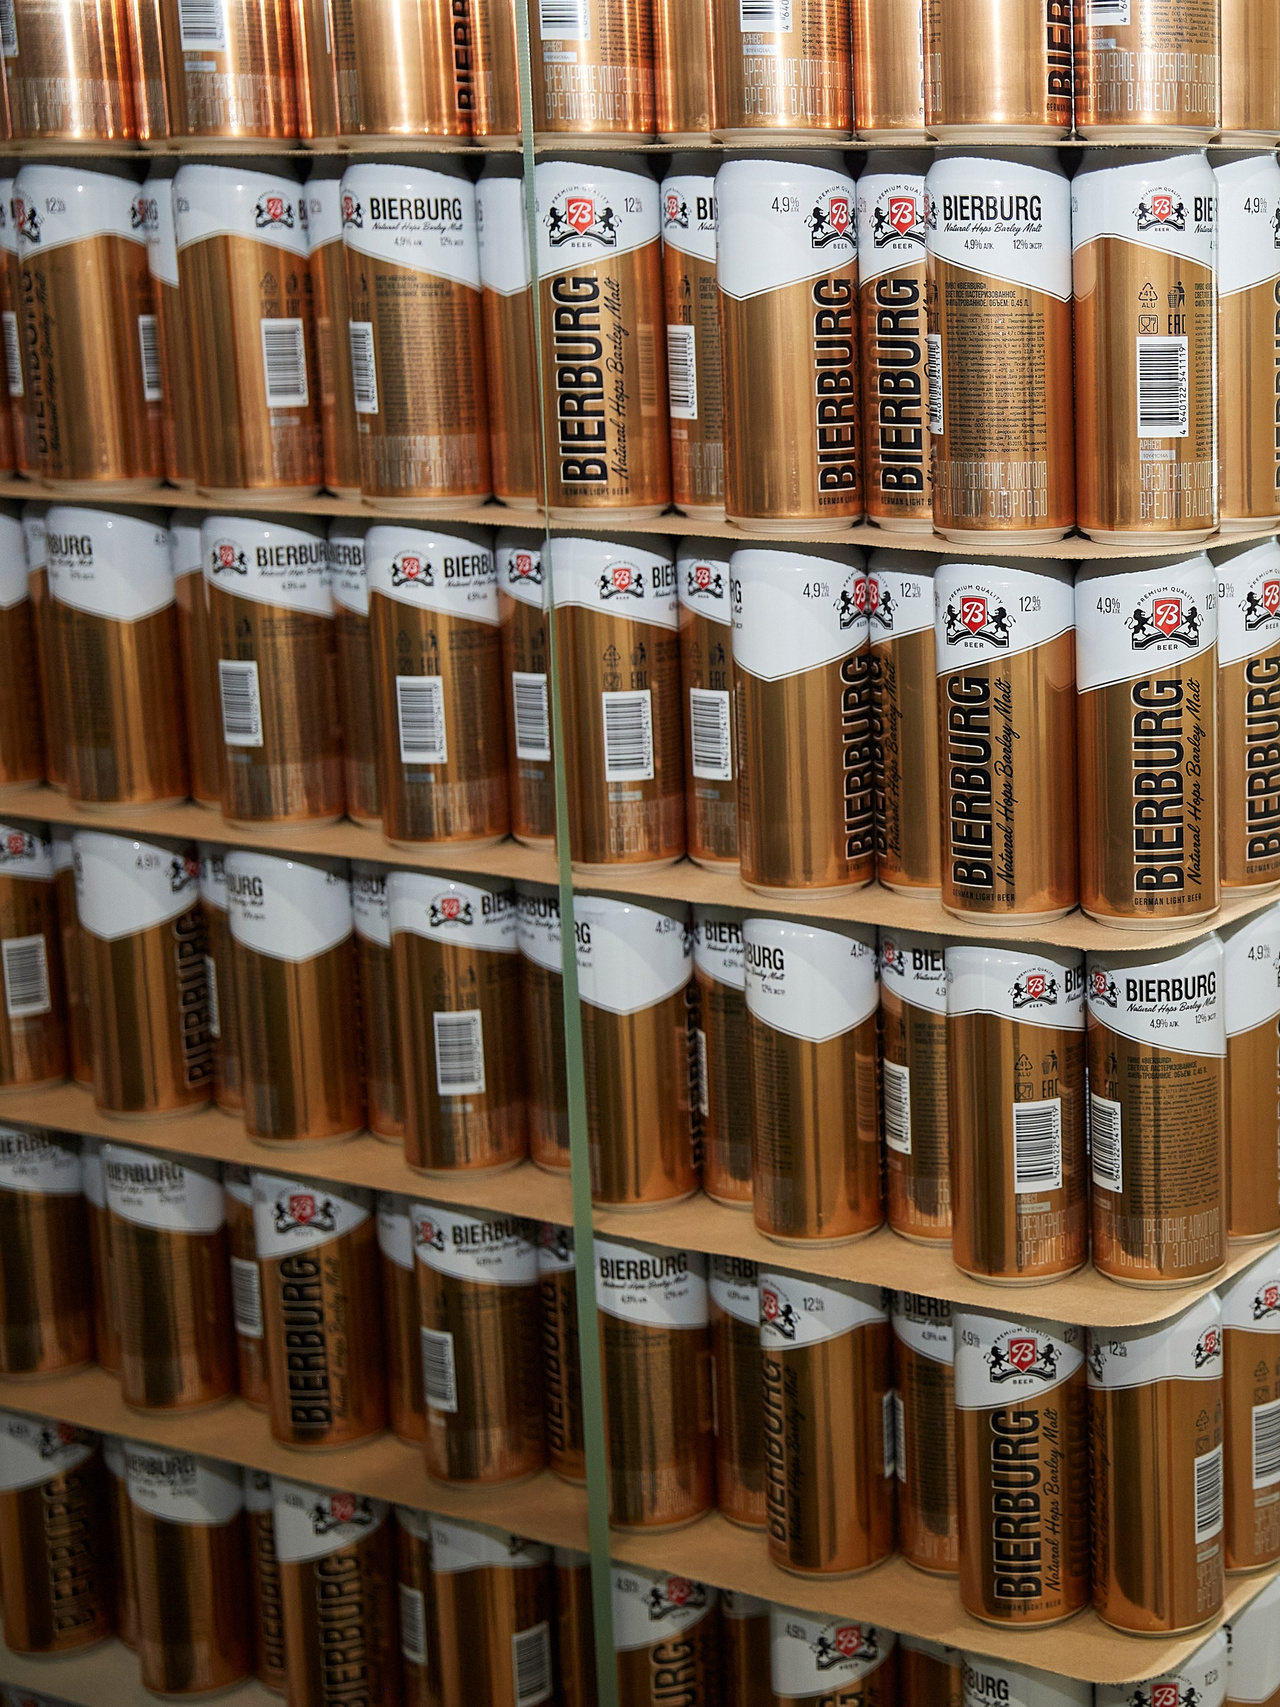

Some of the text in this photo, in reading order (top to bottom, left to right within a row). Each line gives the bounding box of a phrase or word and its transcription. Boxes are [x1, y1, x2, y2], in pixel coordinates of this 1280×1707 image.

[370, 197, 462, 220] BIERBURG
[569, 202, 592, 226] B
[892, 202, 916, 225] B
[943, 195, 1042, 221] BIERBURG
[943, 222, 972, 233] Natural
[971, 222, 993, 235] Hops
[1022, 222, 1043, 233] Malt
[1167, 314, 1187, 335] EAC
[551, 276, 608, 484] BIERBURG
[604, 276, 630, 480] Natural Hops Barley Malt
[812, 279, 856, 492] BIERBURG
[875, 279, 923, 492] BIERBURG
[989, 489, 1048, 518] ЗДОРОВЬЮ
[948, 586, 1004, 605] PREMIUM QUALITY
[1136, 586, 1197, 608] PREMIUM QUALITY
[1264, 584, 1280, 607] B
[962, 601, 985, 624] B
[1154, 603, 1179, 628] B
[964, 641, 986, 649] BEER
[1157, 643, 1179, 651] BEER
[946, 675, 993, 889] BIERBURG
[993, 677, 1020, 887] Natural Hops Barley Malt
[1130, 678, 1185, 893] BIERBURG
[1185, 677, 1206, 886] Natural Hops Barley Malt
[1134, 893, 1202, 906] GERMAN LIGHT BEER
[1028, 977, 1044, 994] B
[1126, 971, 1216, 1003] BIERBURG
[1126, 1003, 1156, 1015] Natural
[1157, 1001, 1178, 1014] Hops
[600, 1251, 688, 1281] BIERBURG
[279, 1257, 332, 1428] BIERBURG
[994, 1327, 1023, 1344] PREMIUM
[1011, 1342, 1034, 1364] B
[990, 1409, 1042, 1600] BIERBURG
[1042, 1407, 1065, 1592] Natural Hops Barley Malt
